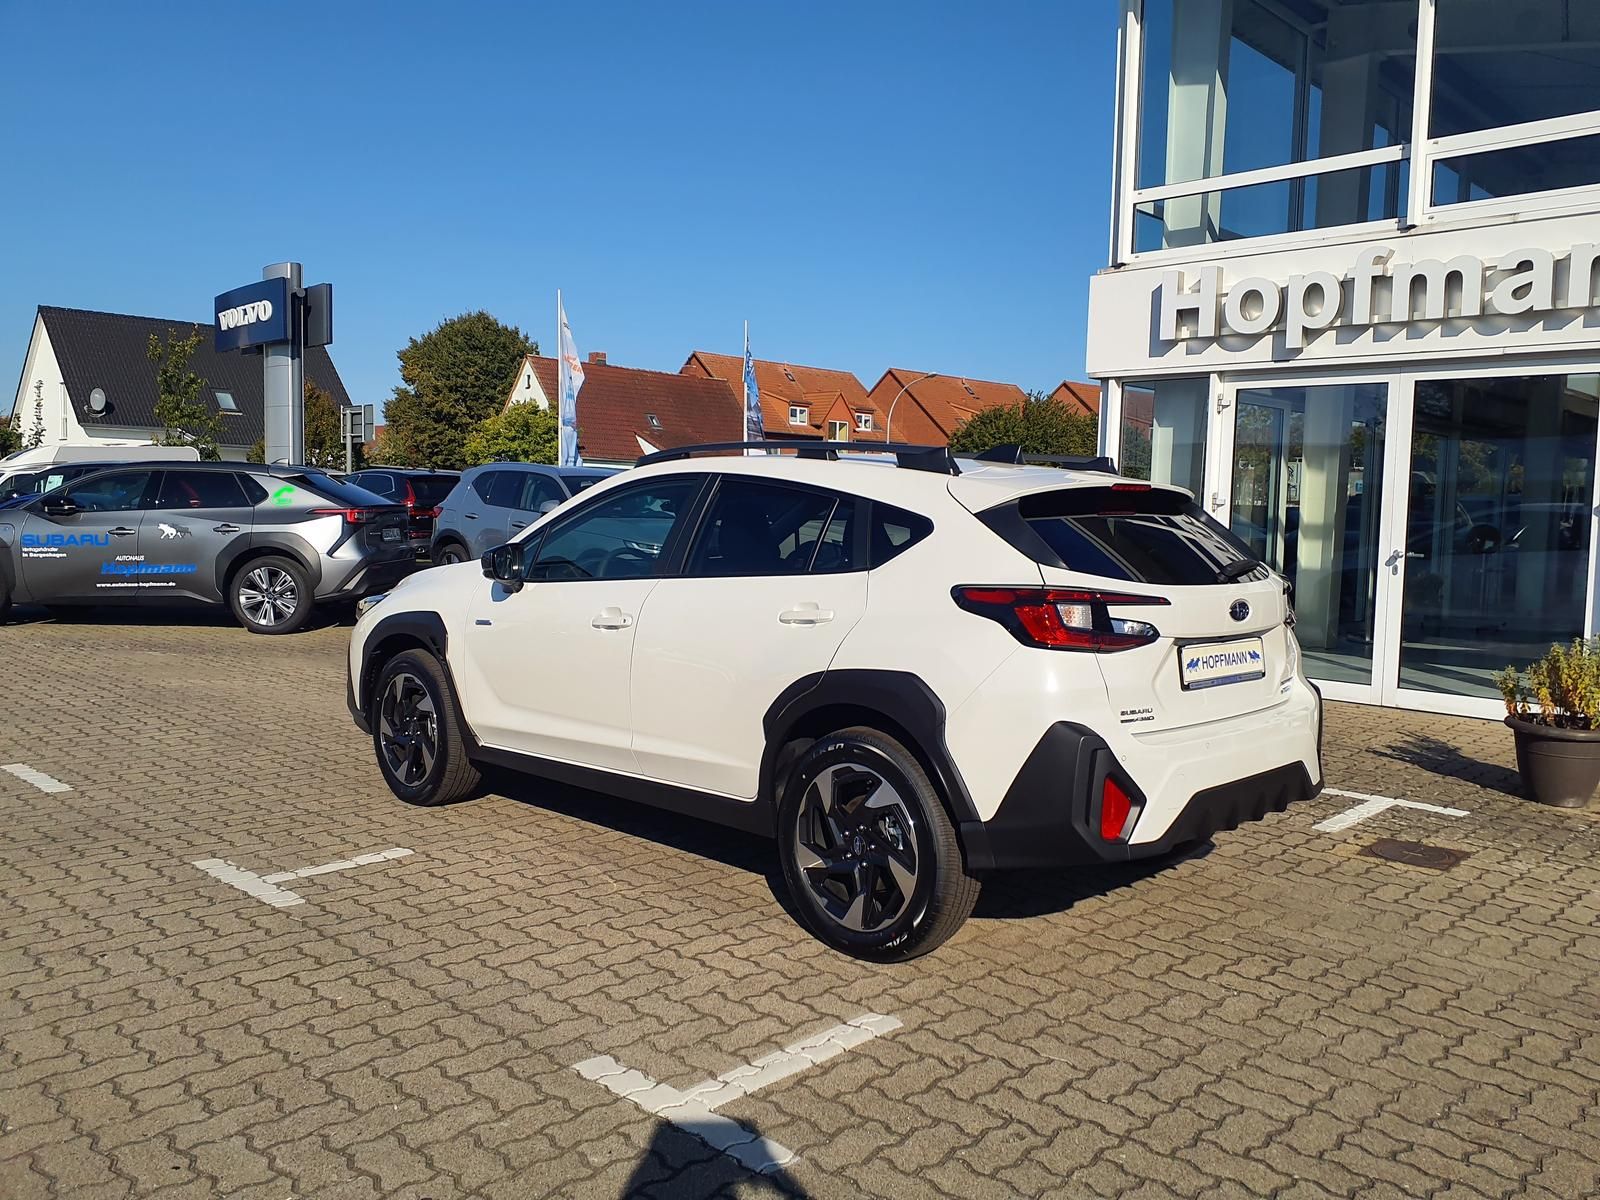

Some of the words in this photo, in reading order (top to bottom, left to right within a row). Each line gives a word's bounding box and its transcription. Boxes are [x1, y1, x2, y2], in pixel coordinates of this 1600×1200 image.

[218, 300, 273, 331] VOLVO
[22, 533, 109, 547] SUBARU
[101, 562, 198, 577] Hopfmann
[1202, 651, 1248, 669] HOPFMANN
[1120, 708, 1153, 716] SUBARU
